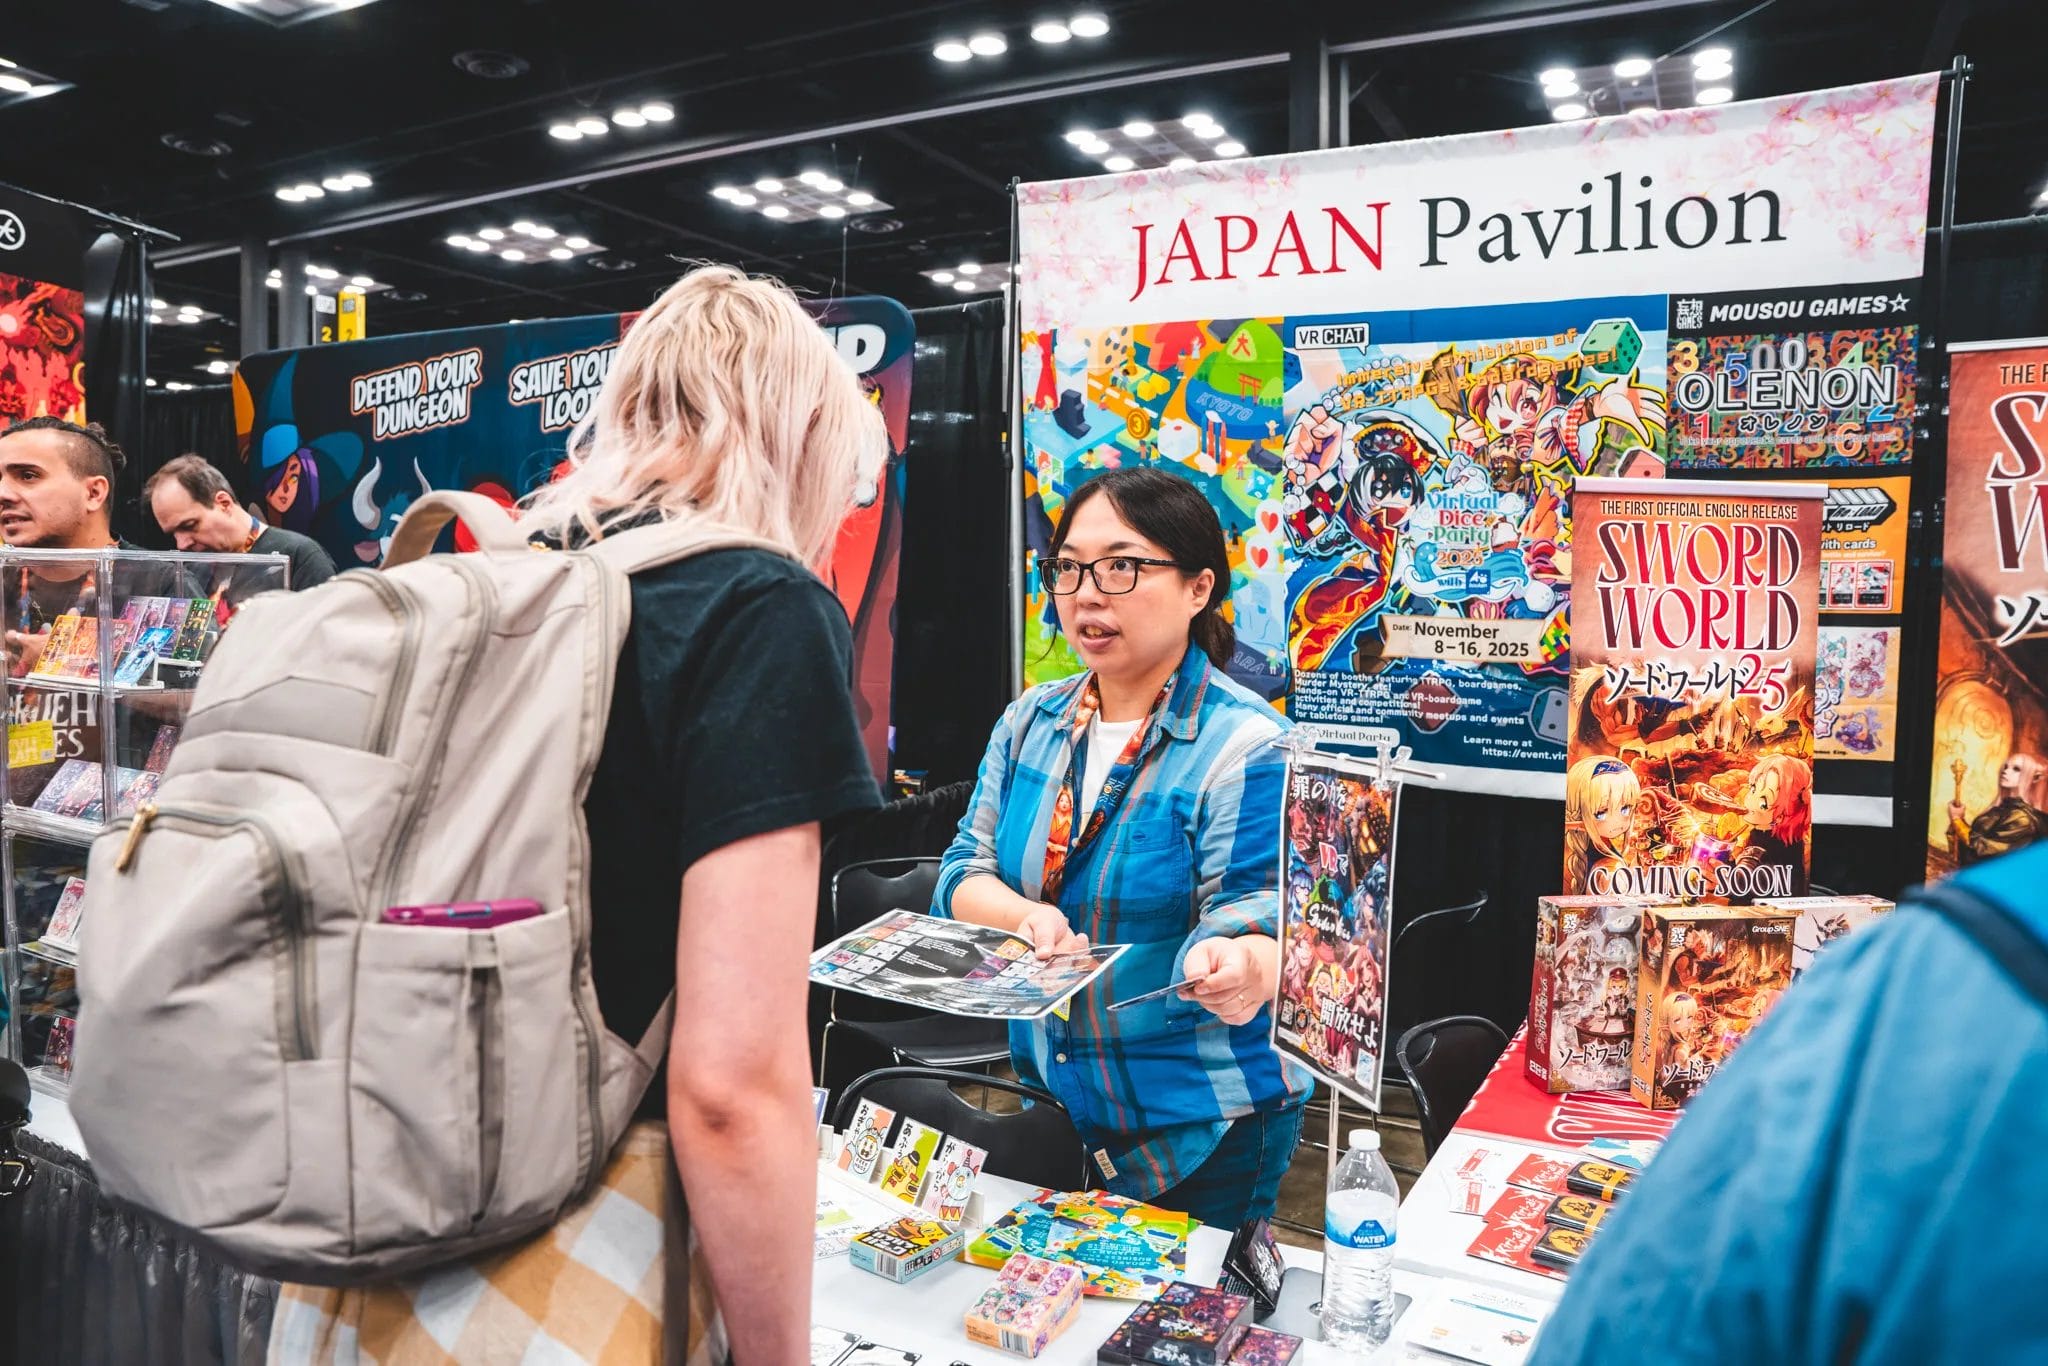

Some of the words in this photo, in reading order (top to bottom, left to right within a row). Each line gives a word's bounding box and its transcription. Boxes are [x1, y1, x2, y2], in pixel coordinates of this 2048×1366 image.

[1129, 202, 1392, 302] JAPAN
[1419, 171, 1787, 267] Pavilion
[1709, 301, 1804, 323] MOUSOU
[322, 326, 332, 342] 2
[1233, 332, 1251, 356] 大
[1299, 327, 1319, 344] VR
[1323, 326, 1365, 343] CHAT
[1336, 359, 1433, 386] Immersive
[1442, 337, 1548, 368] exhibition
[1553, 327, 1578, 346] of
[1476, 346, 1618, 387] boardgames!
[353, 364, 423, 412] DEFEND
[425, 350, 480, 392] YOUR
[511, 356, 567, 401] SAVE
[570, 347, 620, 389] YOU
[2000, 364, 2036, 385] THE
[1677, 364, 1898, 412] OLENON
[375, 387, 469, 438] DUNGEON
[1196, 391, 1253, 422] KYOTO
[1132, 414, 1143, 433] 3
[1739, 413, 1829, 432] オレノン
[1426, 492, 1499, 509] Virtual
[1601, 499, 1621, 515] THE
[1625, 500, 1653, 516] FIRST
[1657, 502, 1702, 517] OFFICIAL
[1706, 503, 1749, 518] ENGLISH
[1752, 504, 1798, 520] RELEASE
[1440, 510, 1484, 526] Dice
[1836, 521, 1871, 532] リロード
[1434, 525, 1490, 545] Party
[1843, 538, 1876, 549] cards
[1436, 550, 1484, 566] 2025
[1598, 522, 1800, 587] SWORD
[1438, 576, 1462, 587] with
[1598, 586, 1799, 650] WORLD
[1392, 623, 1412, 631] Date:
[1414, 622, 1500, 639] November
[1488, 642, 1530, 657] 2025
[1294, 670, 1327, 680] Dozens
[1329, 671, 1339, 680] of
[1342, 672, 1373, 682] booths
[1420, 677, 1456, 688] TTRPG,
[1458, 679, 1522, 691] boardgames,
[1295, 678, 1327, 688] Murder
[1329, 680, 1369, 691] Mystery,
[1372, 682, 1392, 692] etc!
[1295, 686, 1338, 696] Hands-on
[1340, 688, 1391, 699] VR-TTRPG
[1411, 692, 1482, 706] VR-boardgame
[1295, 694, 1337, 704] activities
[1339, 696, 1357, 706] and
[1295, 701, 1319, 712] Many
[1320, 703, 1354, 713] official
[1356, 706, 1374, 715] and
[1375, 708, 1424, 718] community
[1425, 711, 1467, 722] meetups
[1469, 713, 1488, 723] and
[1490, 716, 1525, 725] events
[1295, 709, 1307, 718] for
[1309, 710, 1348, 722] tabletop
[1350, 715, 1384, 724] games!
[1317, 728, 1356, 741] Virtual
[1463, 735, 1492, 745] Learn
[1495, 737, 1519, 747] more
[1521, 739, 1533, 748] at
[1482, 747, 1568, 761] https://event.vir
[1588, 865, 1706, 897] COMING
[1714, 864, 1793, 896] SOON
[1321, 996, 1380, 1049] 開放せよ
[1559, 1041, 1634, 1070] ソード・ワール
[1663, 1060, 1717, 1087] ソード・ワ
[1353, 1235, 1386, 1244] WATER
